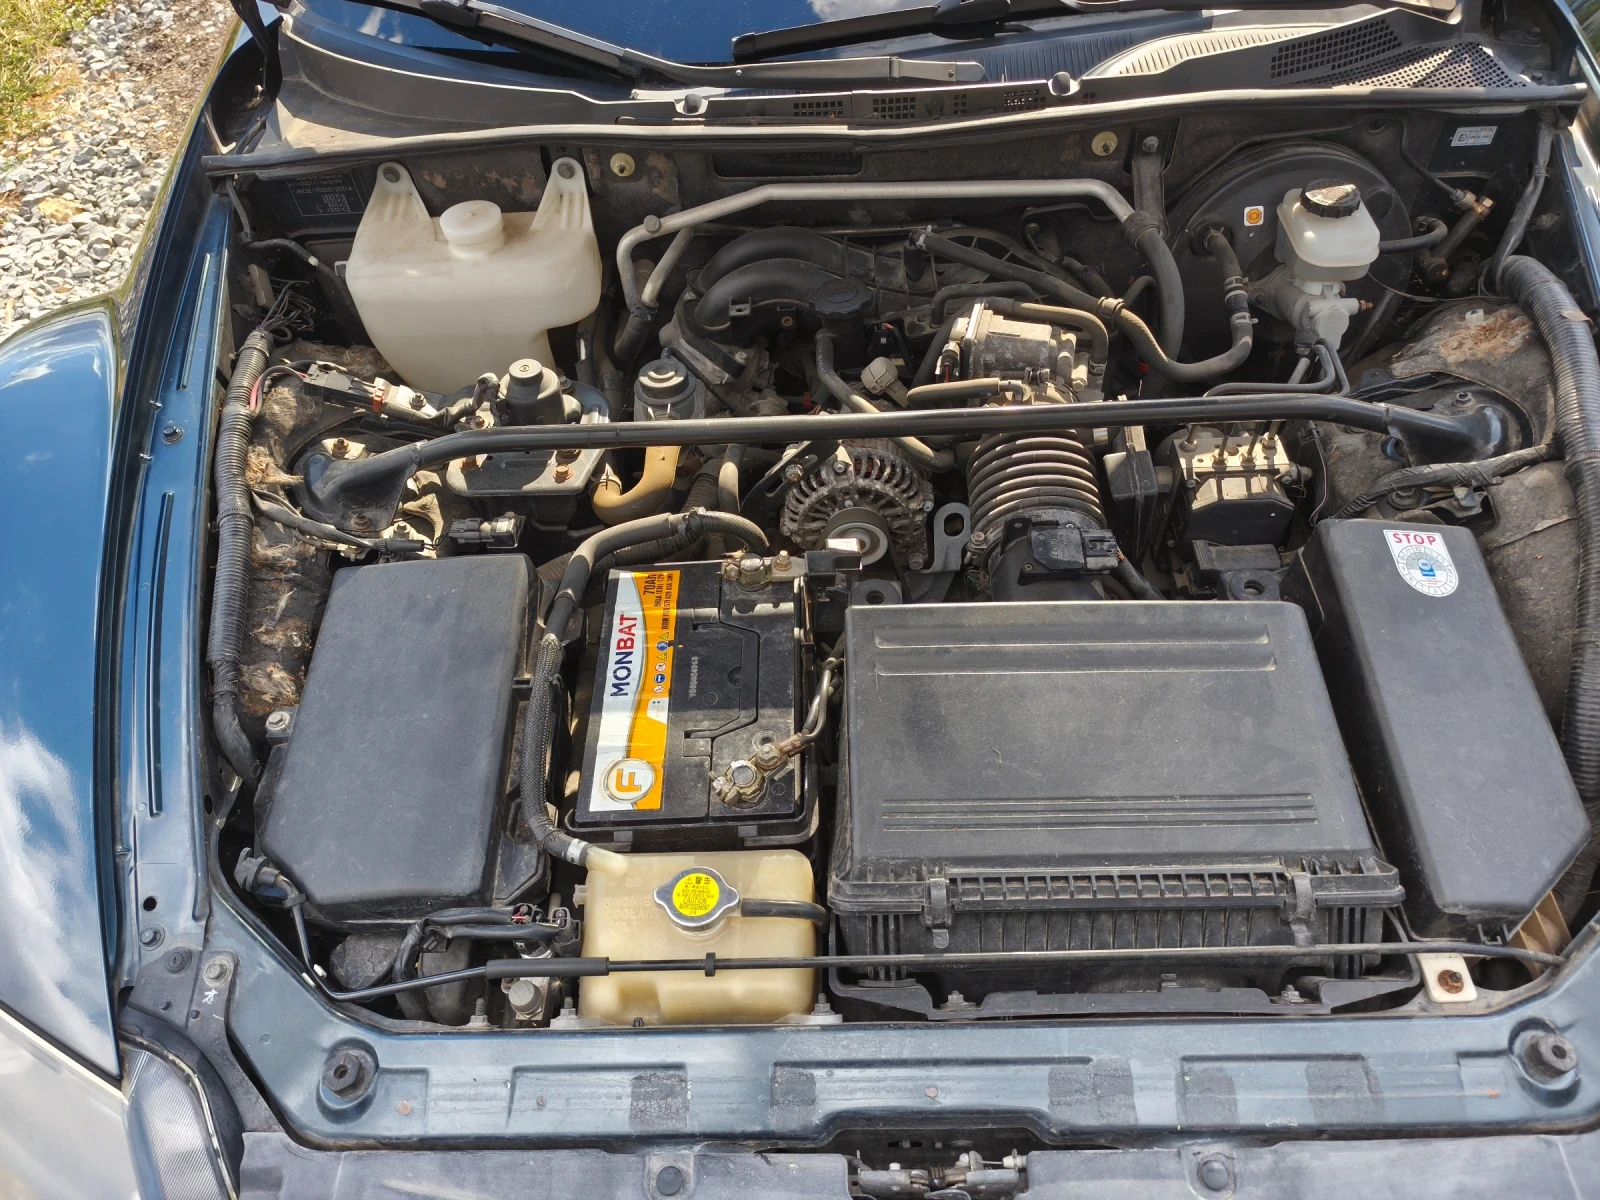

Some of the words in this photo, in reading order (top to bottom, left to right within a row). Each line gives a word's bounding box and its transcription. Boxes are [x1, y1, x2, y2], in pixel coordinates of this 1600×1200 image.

[1393, 533, 1437, 546] STOP
[643, 574, 657, 595] 70Ah
[610, 613, 638, 697] MONBAT
[615, 768, 642, 793] F
